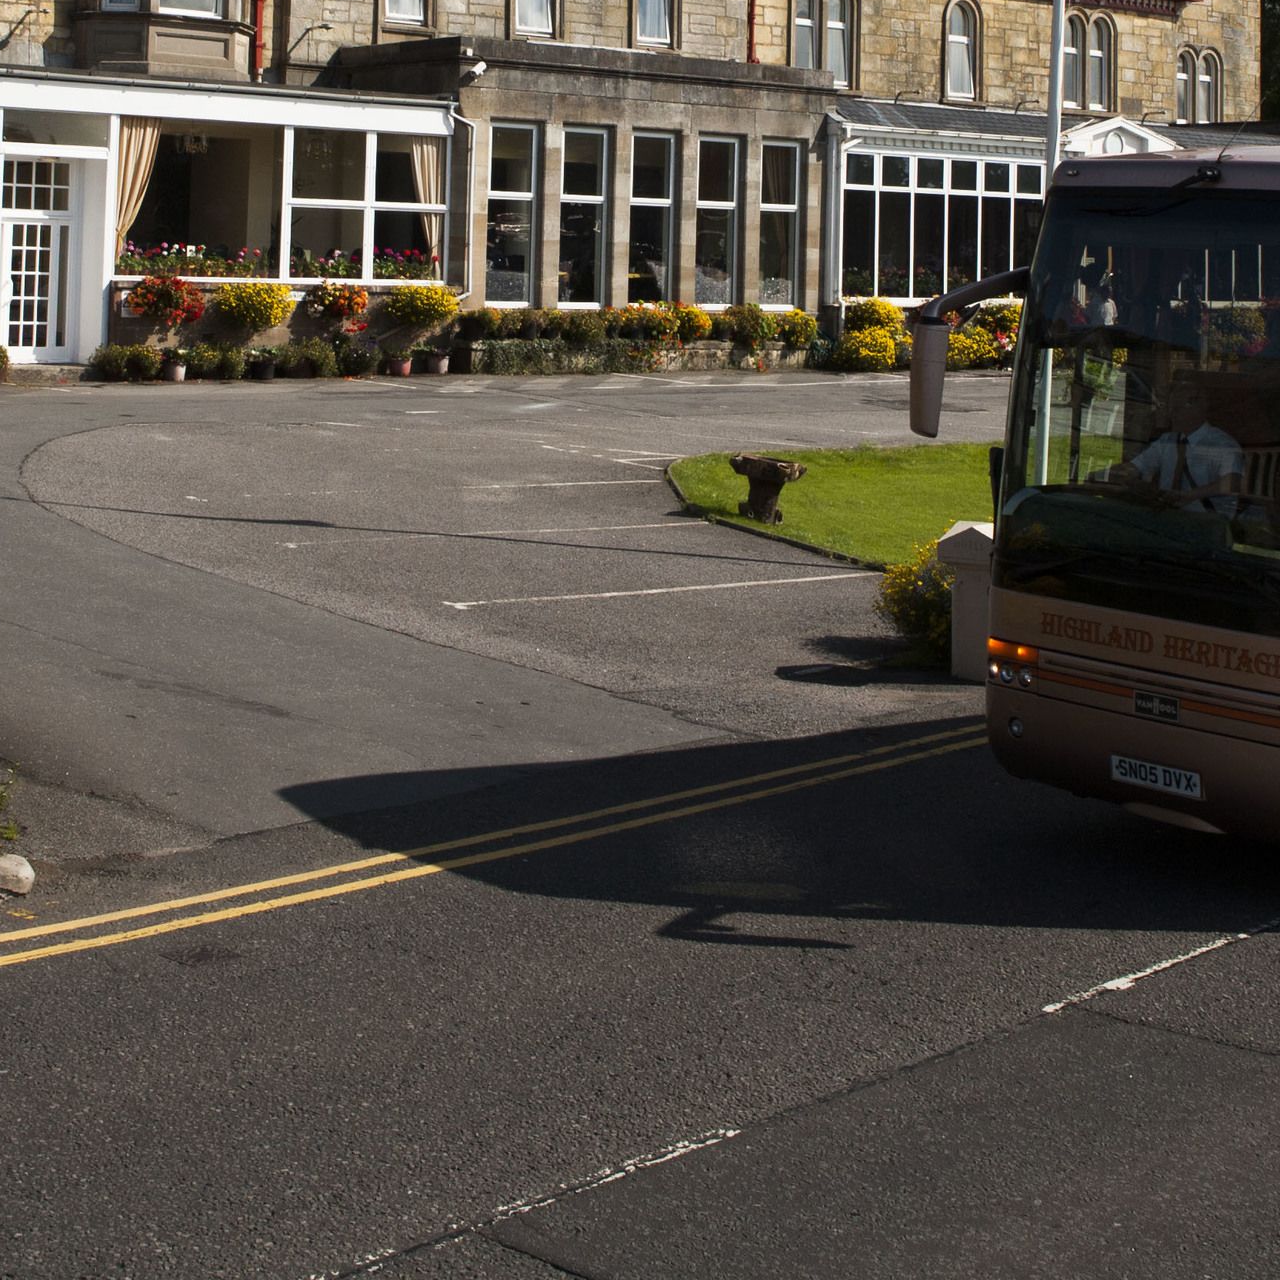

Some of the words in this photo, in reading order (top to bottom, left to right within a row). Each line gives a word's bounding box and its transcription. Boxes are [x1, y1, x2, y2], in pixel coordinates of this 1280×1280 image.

[1040, 612, 1154, 654] HIGHLAND
[1119, 759, 1158, 784] SN05
[1162, 769, 1194, 793] DVX
